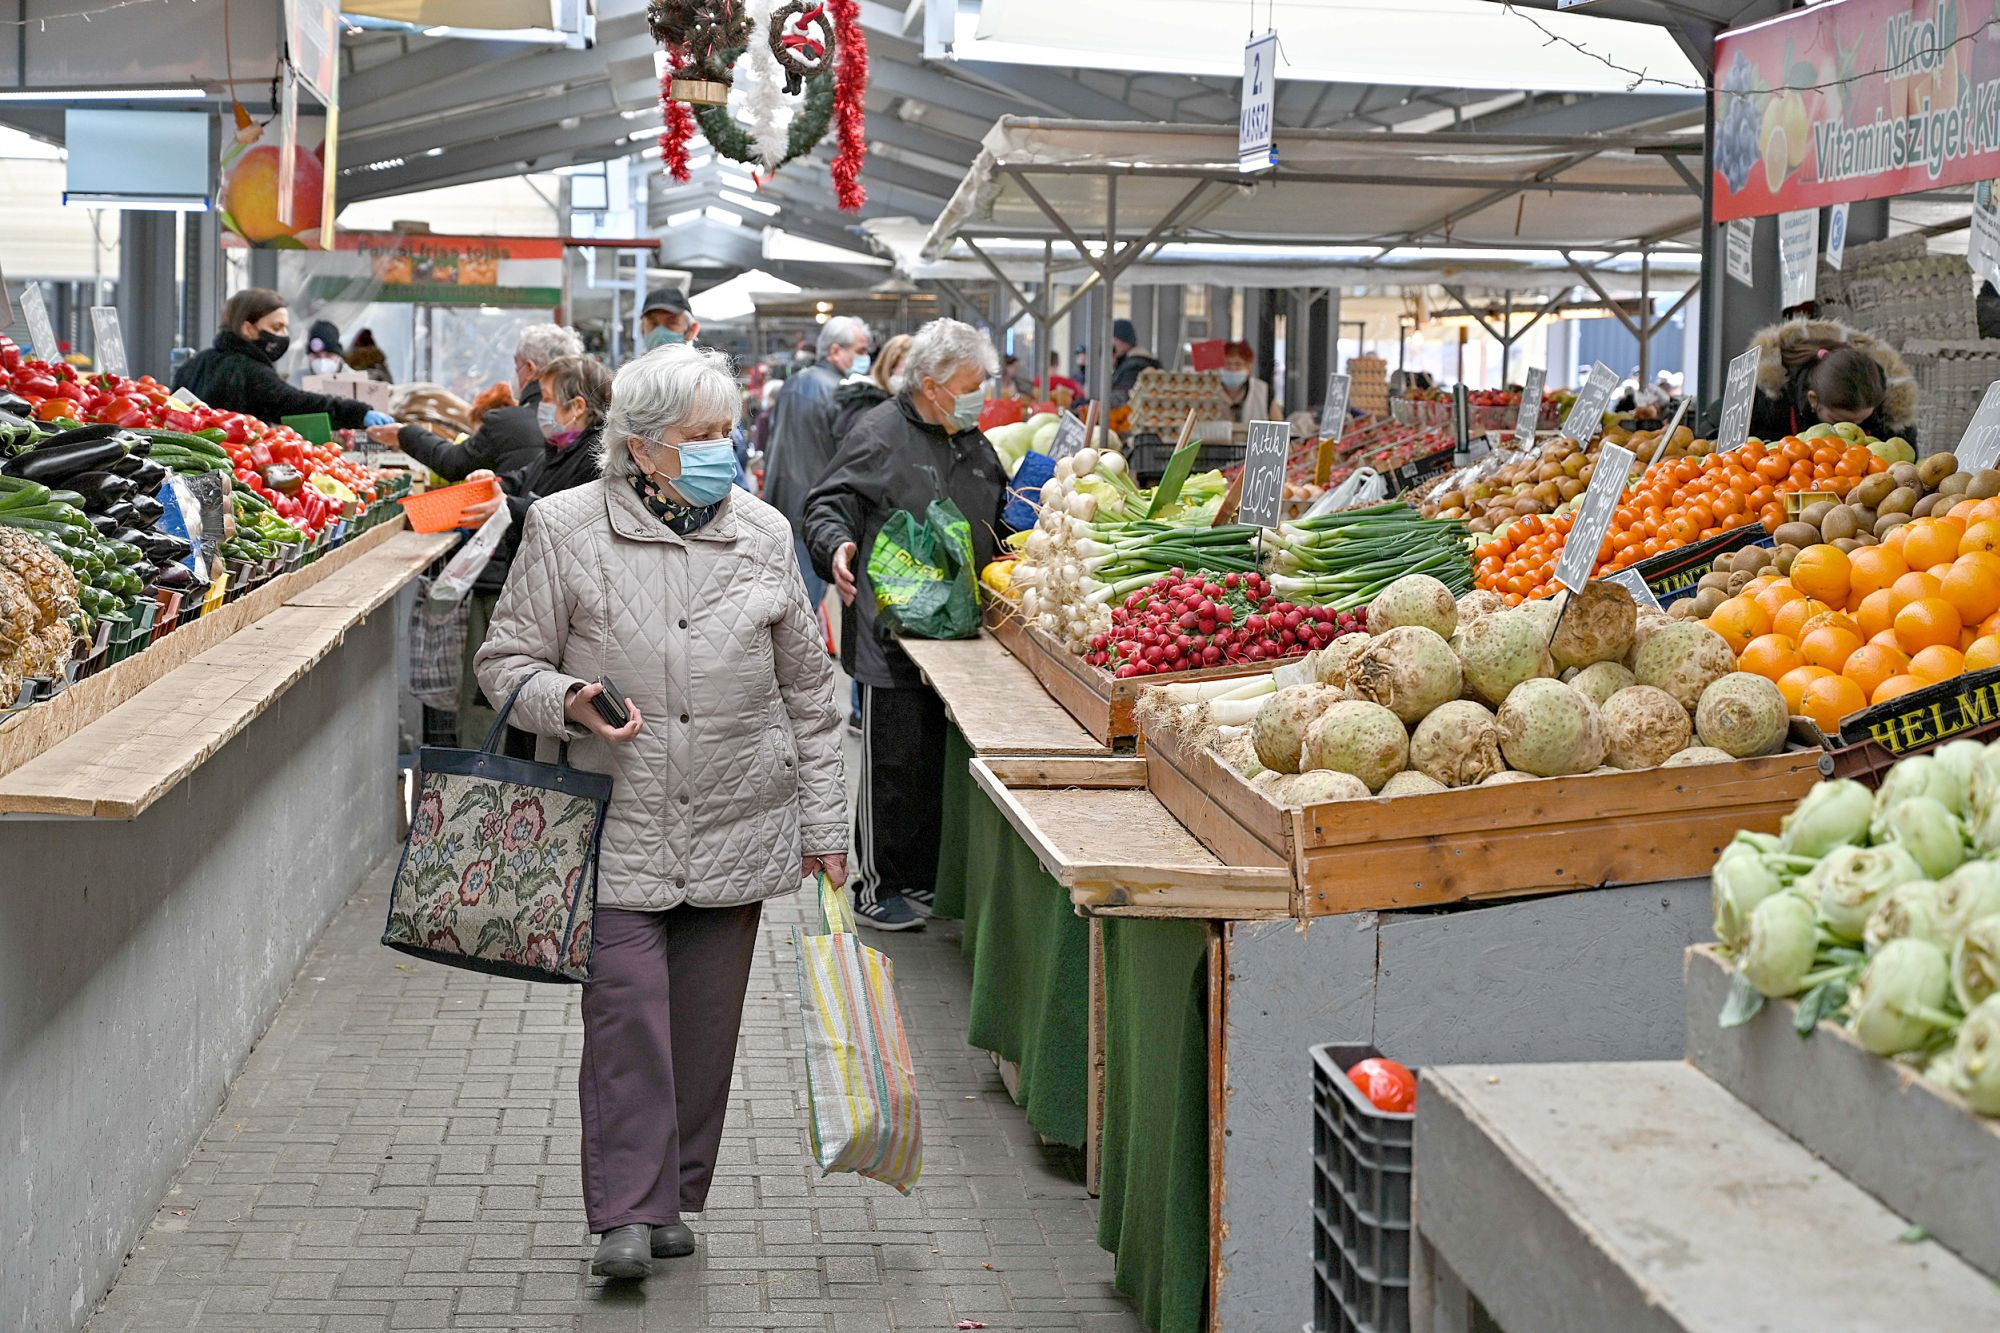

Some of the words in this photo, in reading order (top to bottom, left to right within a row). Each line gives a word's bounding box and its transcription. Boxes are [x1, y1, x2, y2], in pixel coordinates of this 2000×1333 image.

[1885, 2, 1945, 82] Nikol
[1241, 102, 1270, 143] KASSZA
[1814, 88, 1969, 183] Vitaminsziget
